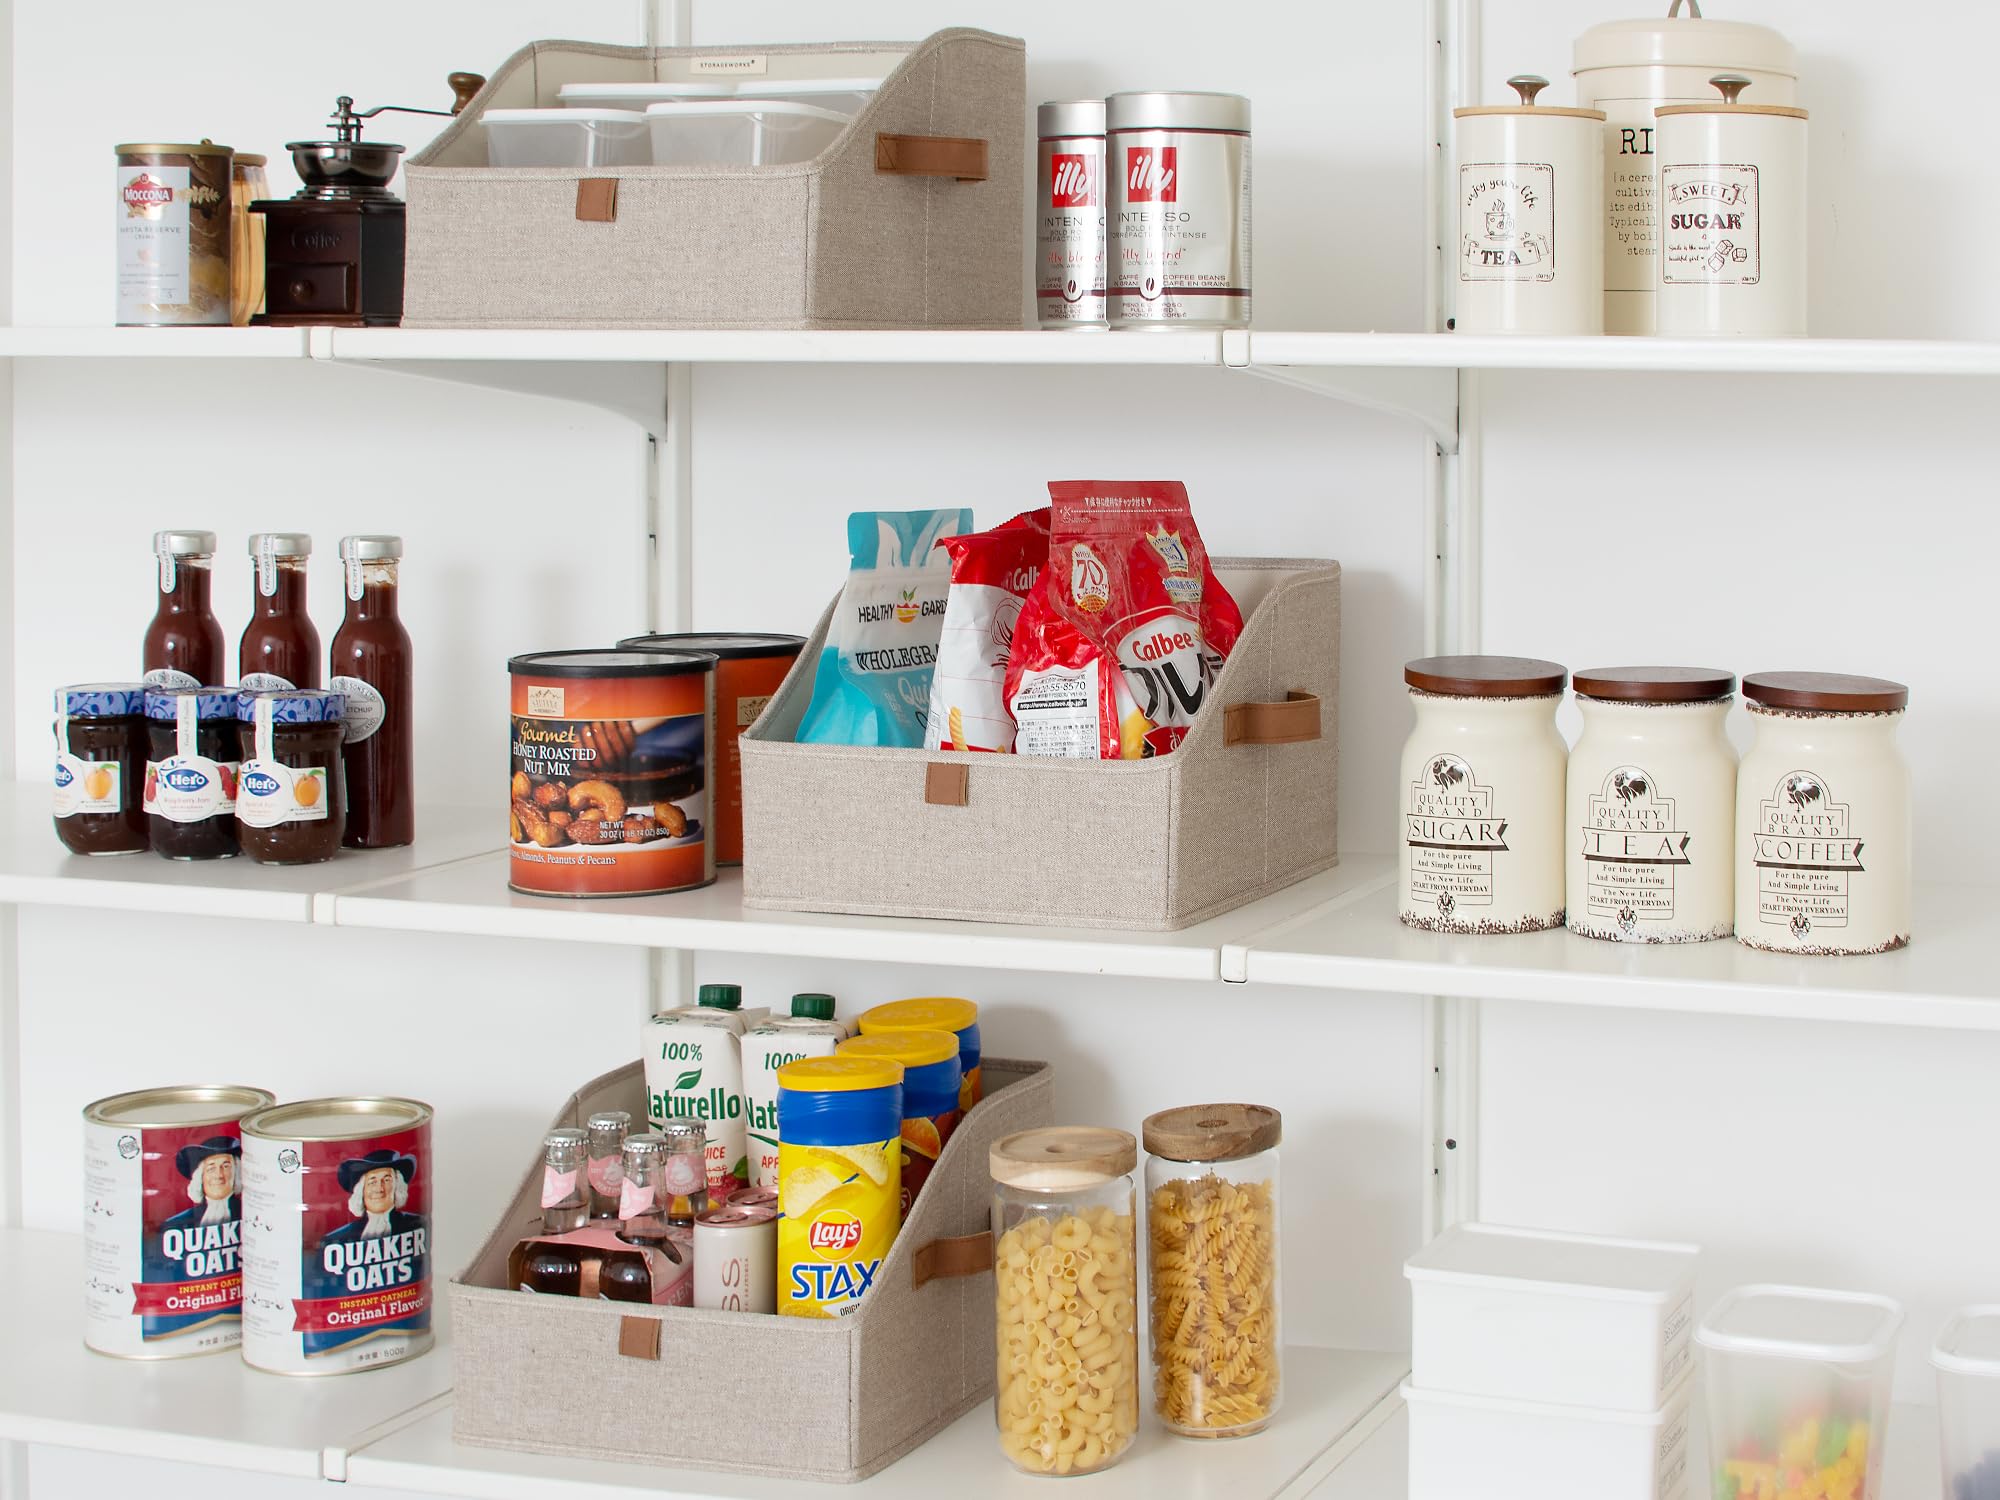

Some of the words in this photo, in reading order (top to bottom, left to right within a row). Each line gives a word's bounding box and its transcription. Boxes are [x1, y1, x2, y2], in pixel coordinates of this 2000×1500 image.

[1620, 128, 1654, 154] RI
[1053, 162, 1093, 203] illy
[1130, 155, 1175, 197] illy
[124, 188, 171, 201] MOCCONA
[1681, 185, 1728, 198] SWEET
[1610, 203, 1625, 212] its
[1045, 217, 1104, 226] INTENO
[1118, 212, 1191, 222] INTESO
[1670, 213, 1742, 229] SUGAR
[1618, 232, 1630, 243] by
[1480, 250, 1521, 265] TEA
[1076, 559, 1104, 589] 70
[858, 603, 895, 623] HEALTHY
[921, 599, 949, 617] GARD
[1132, 632, 1195, 661] Calbee
[520, 721, 578, 745] Gourmet
[513, 741, 538, 758] HONEY
[540, 745, 597, 761] ROASTED
[524, 758, 544, 774] NUT
[547, 761, 571, 776] MIX
[171, 773, 205, 785] Hero
[247, 777, 277, 789] Hero
[1419, 794, 1479, 807] QUALITY
[1417, 805, 1482, 817] BRAND
[1598, 807, 1661, 819] QUALITY
[600, 821, 612, 829] NET
[1596, 819, 1665, 831] BRAND
[1770, 813, 1835, 826] QUALITY
[1412, 820, 1496, 841] SUGAR
[1768, 824, 1839, 837] BRAND
[1591, 832, 1674, 856] TEA
[1761, 839, 1852, 861] COFFEE
[547, 854, 576, 865] Peanuts
[578, 856, 586, 865] &
[587, 856, 616, 865] Pecans
[1423, 850, 1435, 858] For
[1438, 851, 1450, 859] the
[1431, 861, 1453, 871] Simple
[1457, 862, 1482, 871] Living
[1602, 864, 1616, 873] For
[1619, 865, 1632, 873] the
[1635, 867, 1656, 876] pure
[1424, 874, 1435, 882] The
[1457, 876, 1474, 884] Life
[1595, 874, 1608, 882] And
[1611, 875, 1636, 886] Simple
[1640, 876, 1665, 885] Living
[1775, 871, 1789, 879] For
[1792, 871, 1805, 880] the
[1809, 874, 1829, 882] pure
[1413, 881, 1429, 890] START
[1430, 883, 1449, 891] FROM
[1450, 884, 1488, 893] EVERYDAY
[1784, 881, 1810, 891] Simple
[1813, 883, 1839, 892] Living
[1619, 889, 1635, 897] New
[1639, 890, 1657, 898] Life
[1776, 895, 1789, 903] The
[1792, 896, 1809, 904] New
[1813, 897, 1831, 905] Life
[1589, 895, 1608, 904] START
[1610, 897, 1630, 906] FROM
[1631, 898, 1672, 907] EVERYDAY
[1761, 903, 1781, 911] START
[1782, 904, 1803, 913] FROM
[1805, 906, 1845, 915] EVERYDAY
[662, 1042, 703, 1061] 100%
[163, 1221, 241, 1260] QUAK
[812, 1221, 860, 1250] Lay's
[323, 1228, 426, 1275] QUAKER
[346, 1256, 413, 1292] OATS
[791, 1260, 880, 1300] STAX
[179, 1282, 219, 1294] INSTANT
[166, 1289, 226, 1310] Original
[340, 1298, 379, 1309] INSTANT
[380, 1288, 417, 1303] OATMEAL
[327, 1305, 387, 1325] Original
[389, 1297, 424, 1316] Flavor
